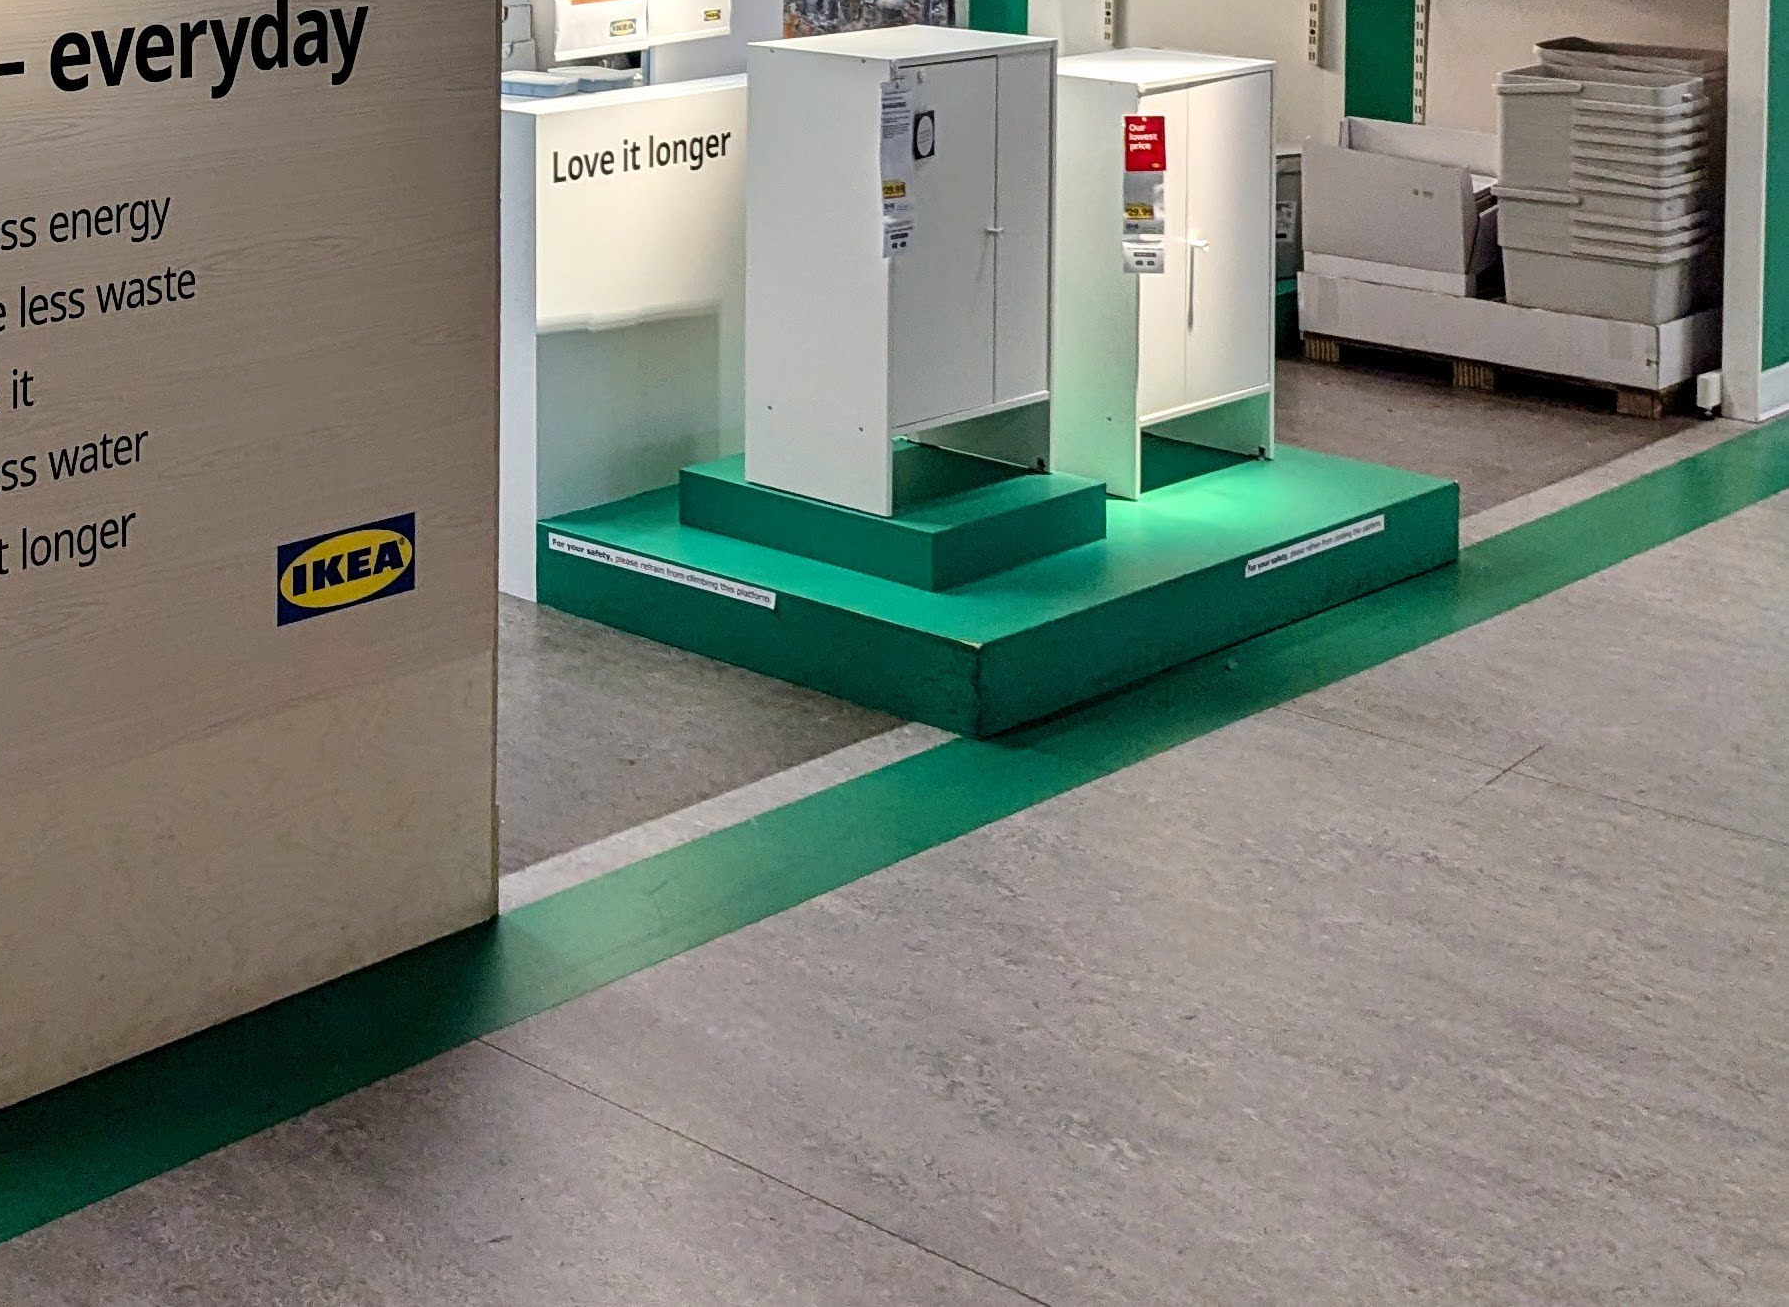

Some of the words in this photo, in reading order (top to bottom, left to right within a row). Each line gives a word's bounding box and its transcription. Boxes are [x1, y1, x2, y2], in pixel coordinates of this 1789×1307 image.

[613, 24, 634, 32] IKEA
[1129, 124, 1146, 132] Our
[1129, 133, 1158, 141] lowest
[1129, 142, 1151, 152] price
[553, 150, 614, 183] Love
[623, 139, 640, 172] it
[649, 132, 731, 171] longer
[49, 197, 172, 243] energy
[19, 286, 85, 328] less
[96, 269, 197, 314] waste
[11, 368, 35, 410] it
[48, 429, 149, 480] water
[21, 512, 137, 572] longer
[292, 539, 405, 597] IKEA
[552, 538, 565, 548] For
[567, 543, 585, 553] your
[587, 547, 613, 562] safety,
[615, 555, 638, 568] please
[641, 561, 665, 574] refrain
[667, 568, 685, 580] from
[686, 573, 718, 590] climbing
[720, 582, 734, 593] this
[737, 588, 771, 603] platform.
